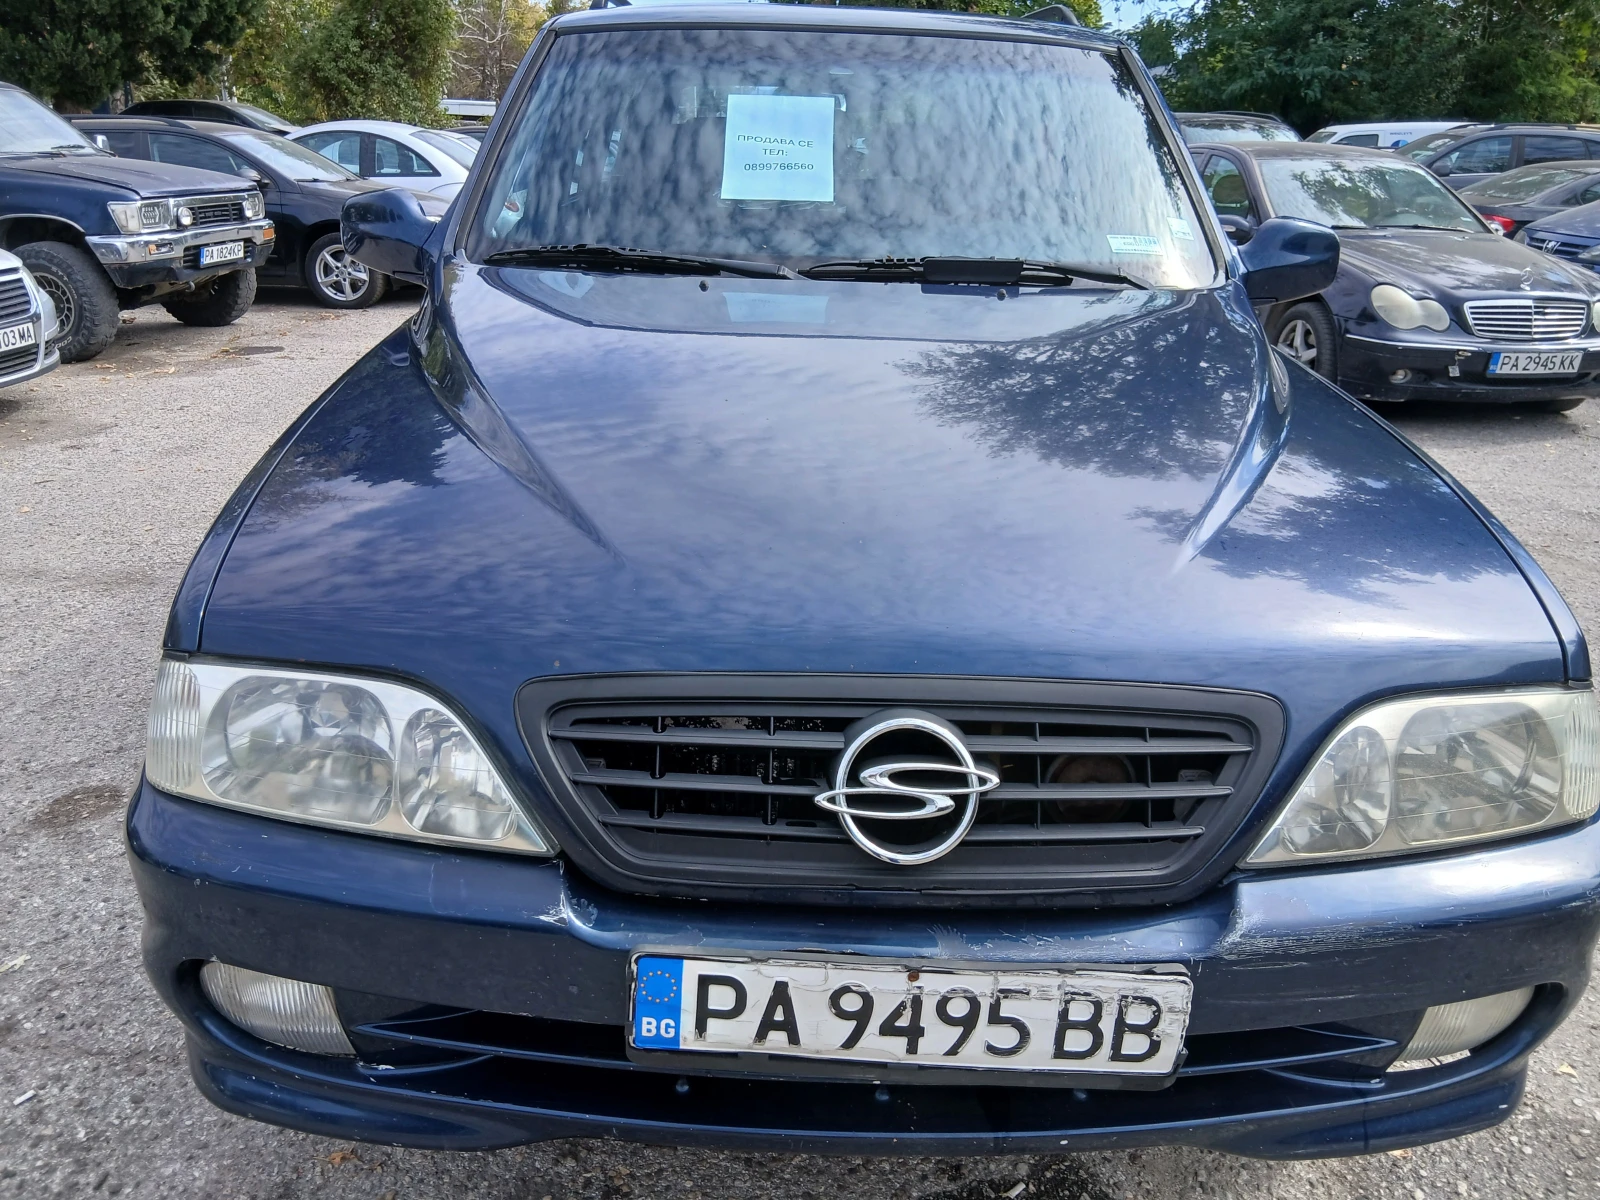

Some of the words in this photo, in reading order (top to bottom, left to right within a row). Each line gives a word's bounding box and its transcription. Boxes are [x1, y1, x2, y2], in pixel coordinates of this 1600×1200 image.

[737, 134, 795, 146] ПРОДАВА
[798, 140, 814, 148] СЕ
[743, 162, 814, 171] 0899766560
[205, 249, 214, 261] PA
[232, 243, 243, 257] KP
[0, 331, 17, 348] 03
[17, 325, 33, 344] MA
[1500, 355, 1519, 371] PA
[1522, 354, 1557, 371] 2945
[1558, 354, 1578, 370] KK
[641, 1016, 676, 1038] BG
[694, 973, 801, 1047] PA
[828, 982, 1031, 1059] 9495
[1051, 989, 1163, 1064] BB
